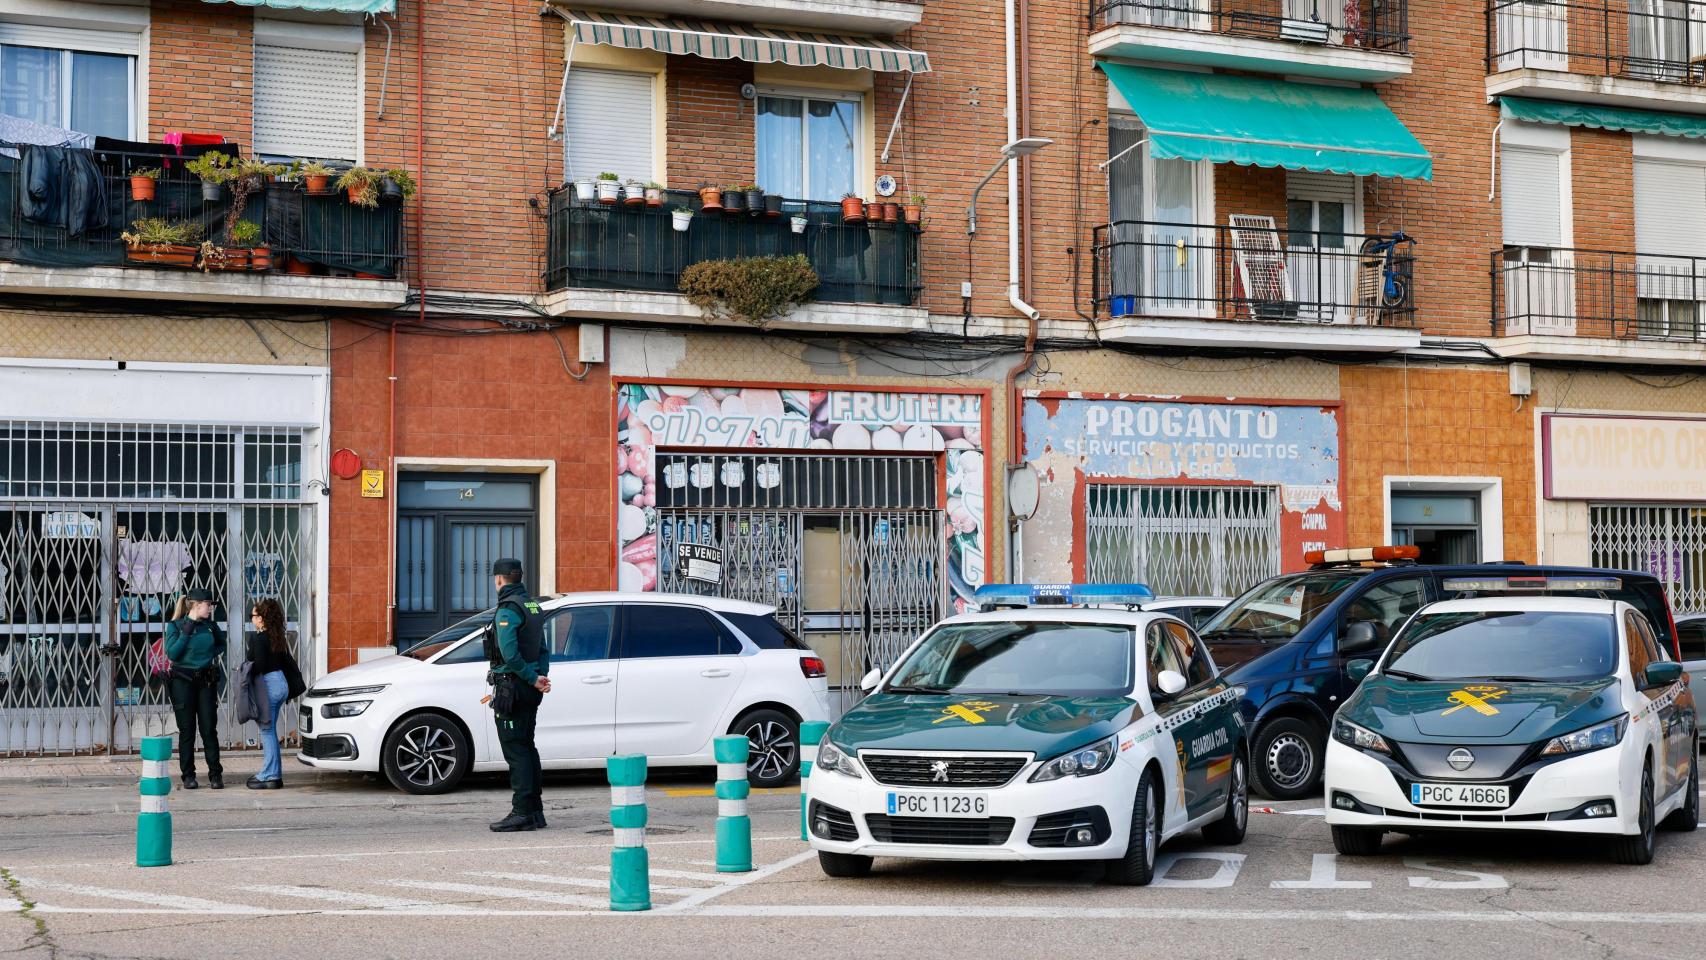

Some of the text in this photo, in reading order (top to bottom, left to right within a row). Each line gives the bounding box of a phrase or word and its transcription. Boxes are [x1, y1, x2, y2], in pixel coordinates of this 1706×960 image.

[1086, 406, 1278, 439] PROGANTO
[1172, 442, 1183, 457] Y
[1555, 425, 1665, 468] COMPRO
[1302, 513, 1327, 530] COMPRA
[679, 545, 721, 562] SE VENDE
[1192, 727, 1228, 758] GUARDIA CIVIL
[898, 795, 927, 812] PGC
[1423, 786, 1505, 804] PGC 4166G
